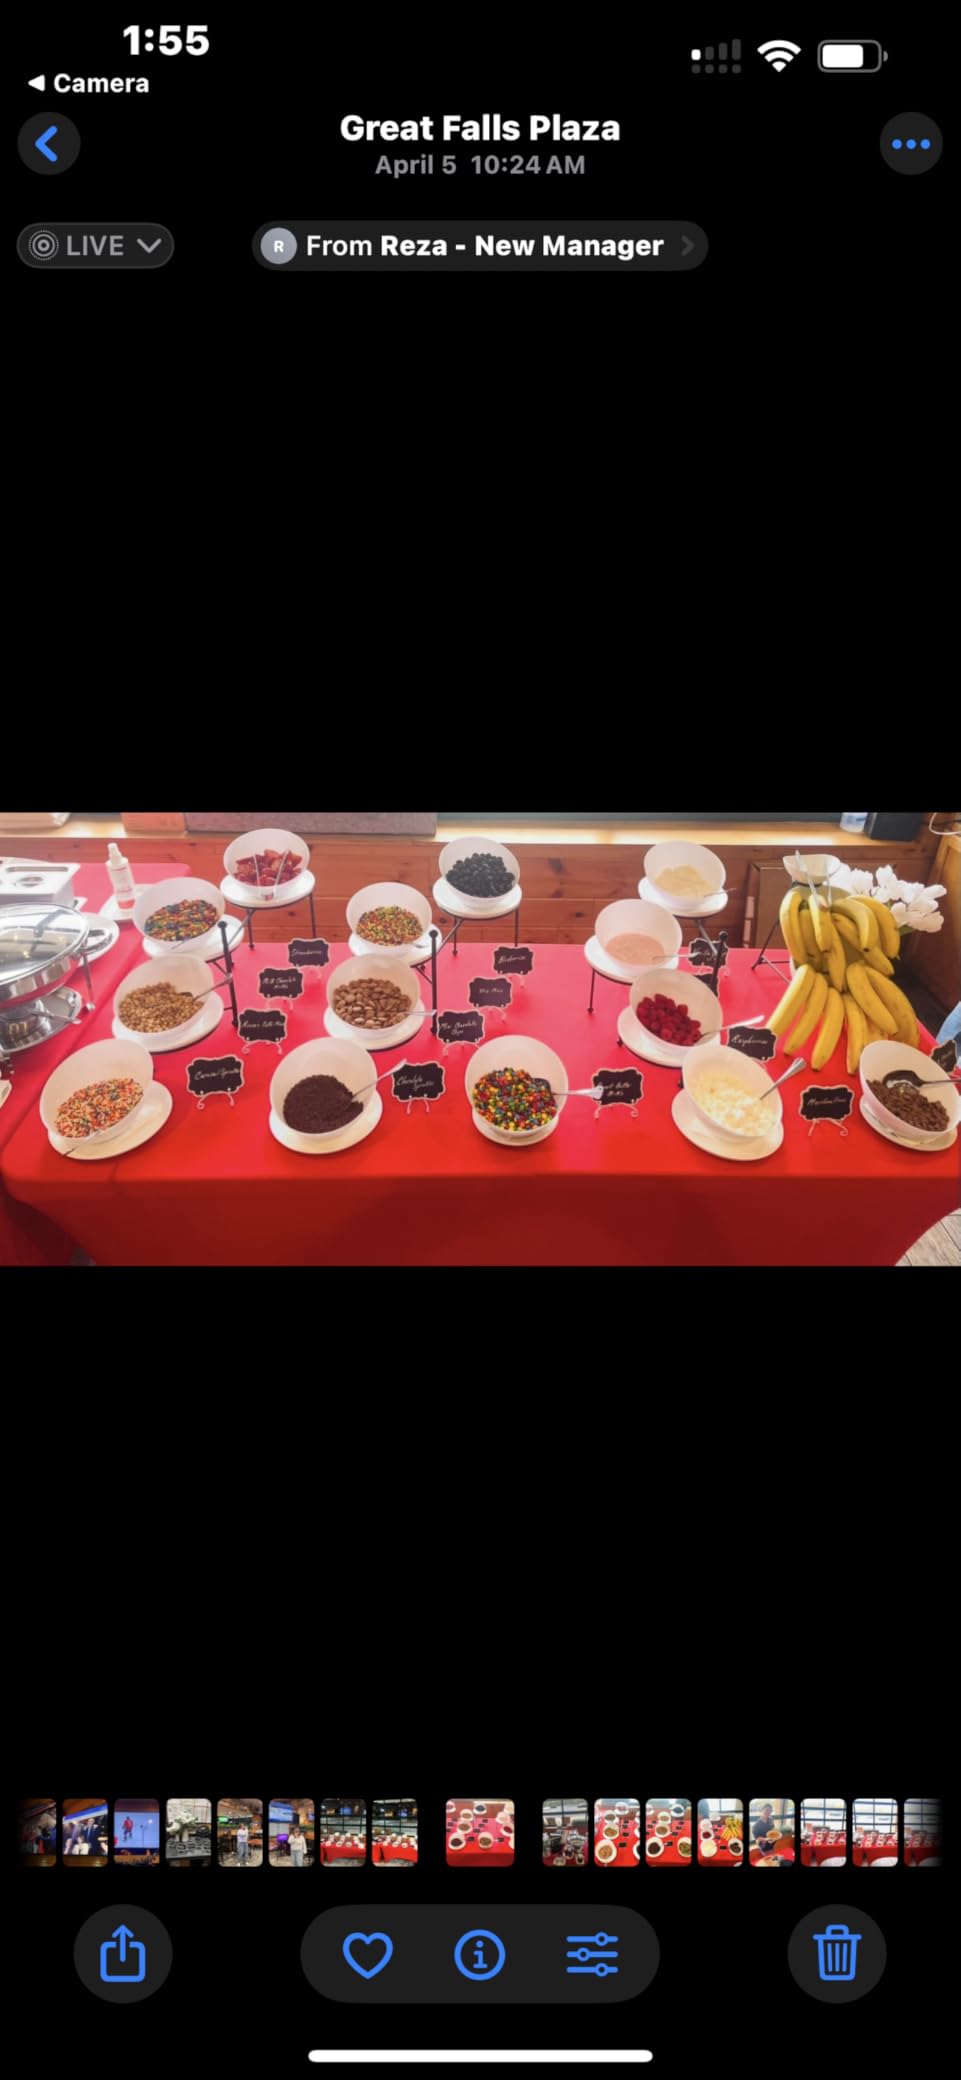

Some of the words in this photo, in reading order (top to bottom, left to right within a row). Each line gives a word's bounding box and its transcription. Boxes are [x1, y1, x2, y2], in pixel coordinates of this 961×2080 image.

[123, 24, 210, 57] 1:55
[53, 72, 150, 94] Camera
[340, 113, 434, 142] Great
[442, 113, 521, 142] Falls
[529, 113, 621, 142] Plaza
[375, 153, 434, 179] April
[442, 154, 457, 175] 5
[470, 154, 542, 175] 10:24
[545, 154, 585, 175] AM
[66, 234, 124, 256] LIVE
[273, 240, 284, 253] R
[306, 234, 373, 257] From
[380, 234, 448, 257] Reza
[475, 234, 536, 257] New
[542, 234, 665, 262] Manager
